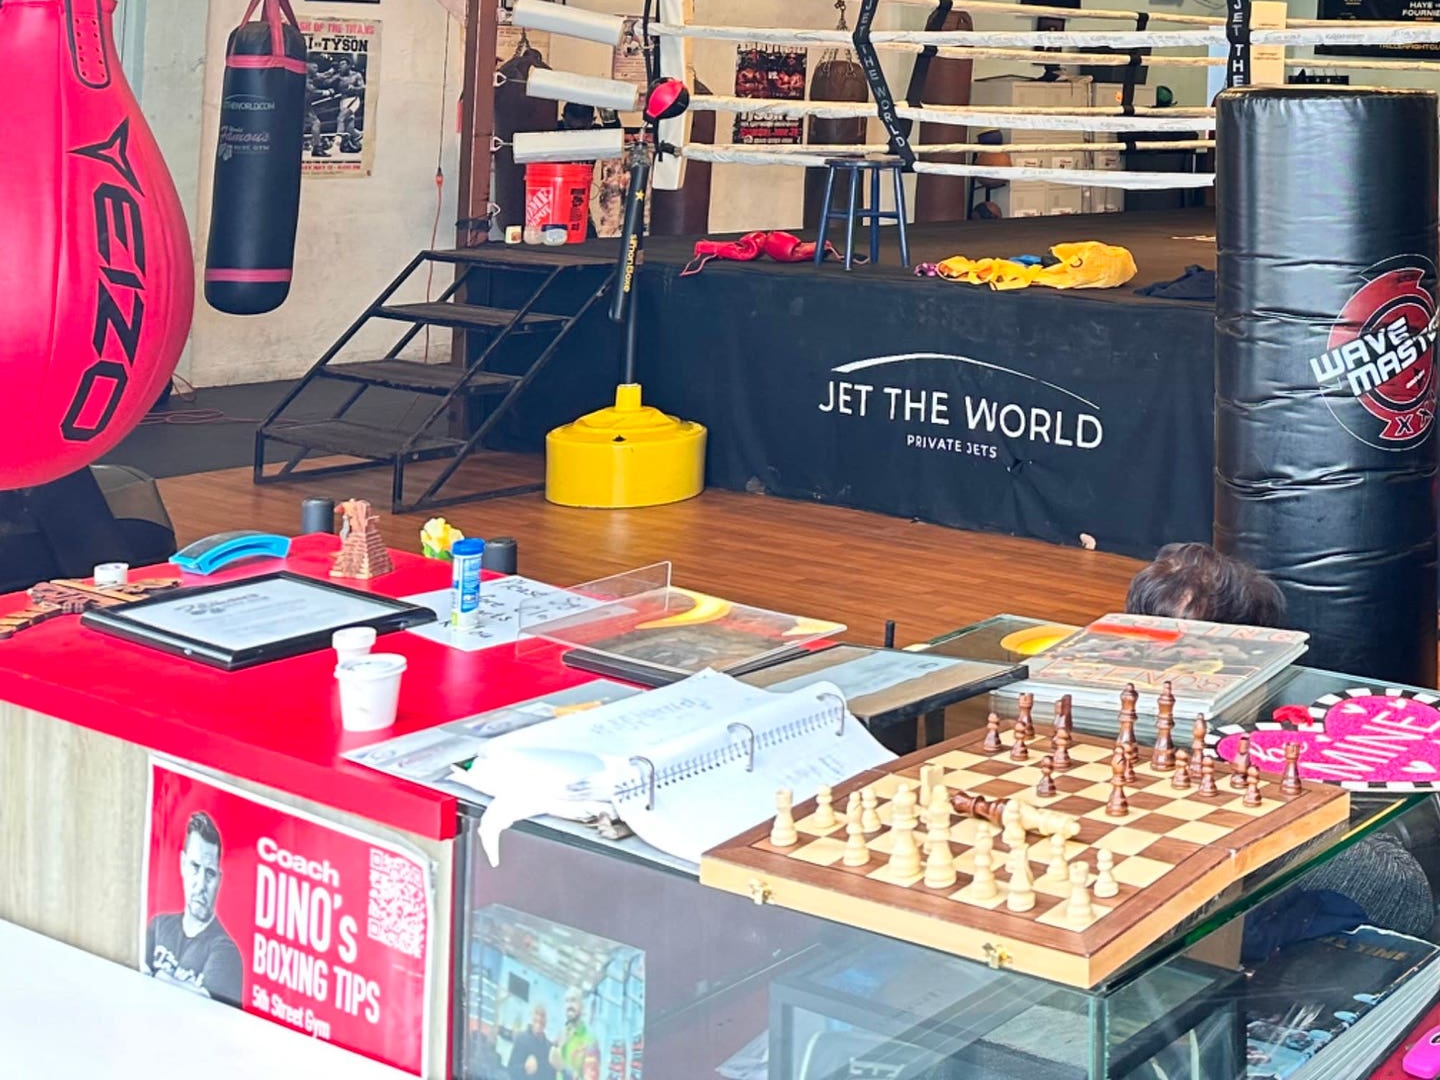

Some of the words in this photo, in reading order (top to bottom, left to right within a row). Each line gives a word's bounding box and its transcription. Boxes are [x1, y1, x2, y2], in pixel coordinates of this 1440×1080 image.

[858, 0, 873, 37] JET
[1409, 1, 1433, 9] HAYE
[323, 38, 368, 52] TYSON
[860, 44, 879, 80] THE
[1232, 44, 1244, 87] THE
[874, 86, 905, 147] WORLD
[1309, 316, 1408, 383] WAVE
[1347, 306, 1440, 397] MAST
[818, 381, 873, 417] JET
[883, 387, 950, 426] THE
[965, 396, 1103, 449] WORLD
[907, 434, 962, 453] PRIVATE
[966, 443, 998, 459] JETS
[257, 836, 340, 887] Coach
[255, 864, 358, 963] DINO's
[253, 933, 328, 1002] BOXING
[333, 968, 380, 1024] TIPS
[252, 985, 270, 1009] 5th
[271, 993, 304, 1023] Street
[306, 1005, 331, 1040] Gym
